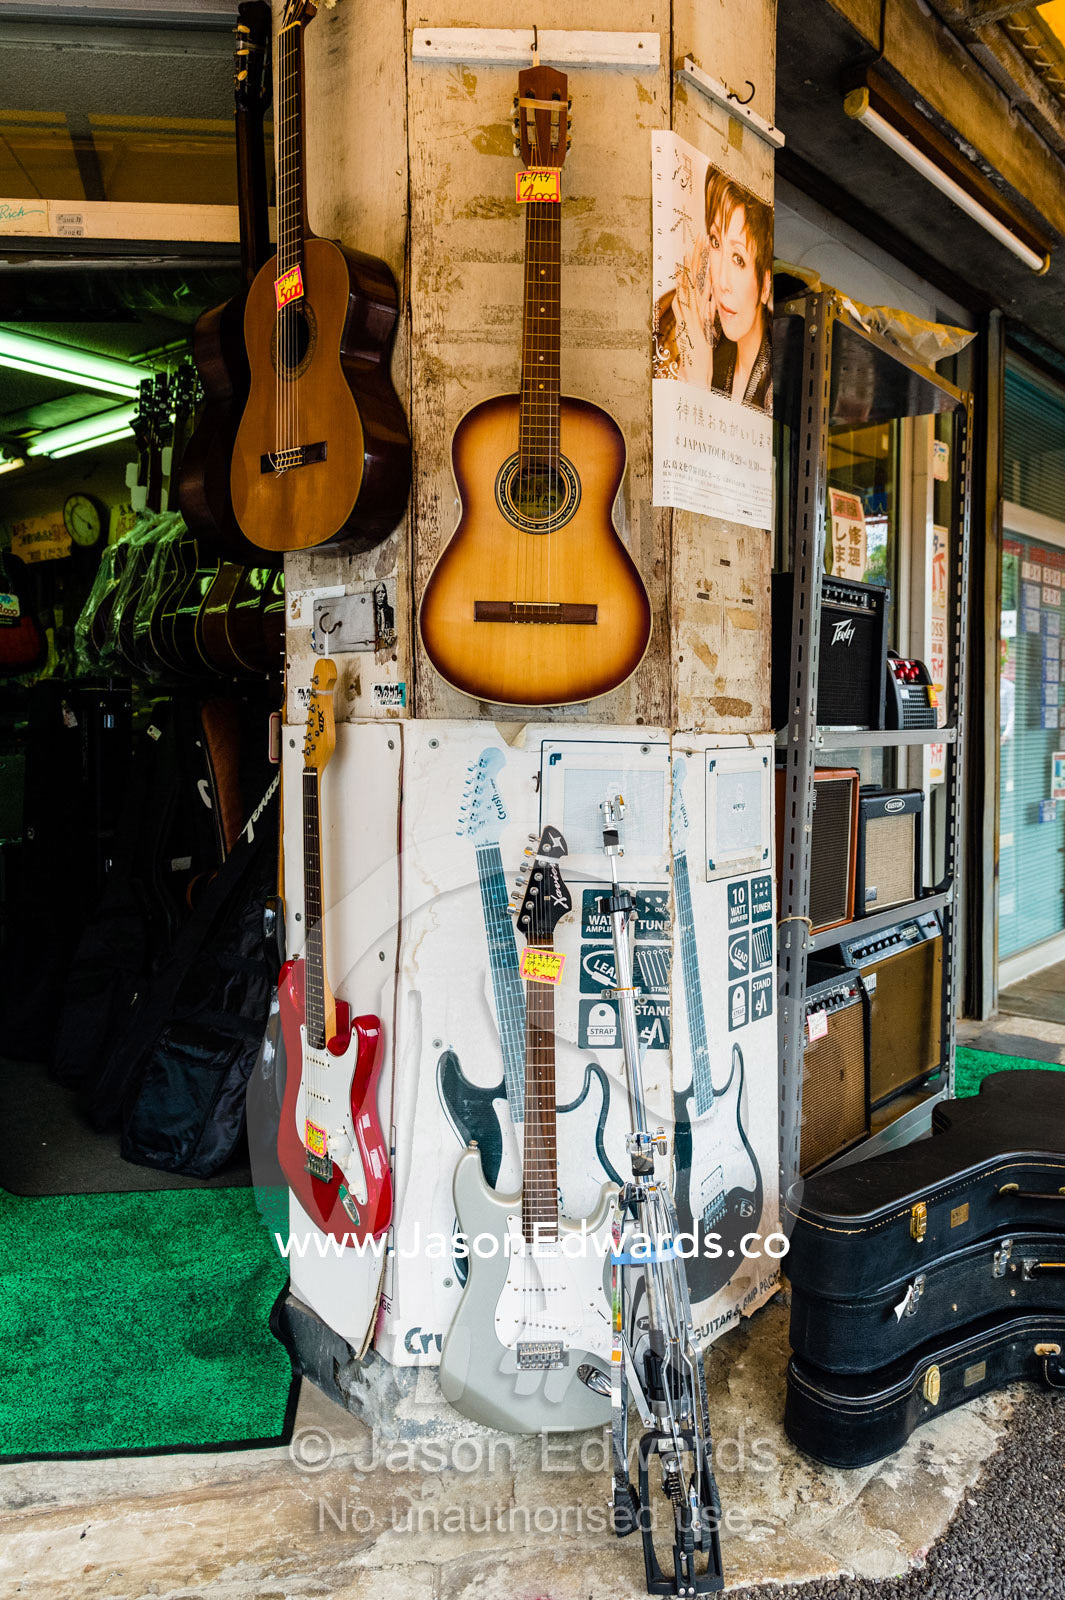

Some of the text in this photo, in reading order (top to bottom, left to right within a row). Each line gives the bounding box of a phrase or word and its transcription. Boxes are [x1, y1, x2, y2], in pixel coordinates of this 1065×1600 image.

[491, 793, 507, 820] Crush
[733, 887, 744, 904] 10
[731, 904, 746, 917] WATT
[753, 902, 771, 914] TUNER
[638, 920, 670, 931] TUNE
[735, 947, 748, 963] LEAD
[594, 960, 616, 979] LEA
[753, 978, 771, 992] STAND
[694, 1310, 732, 1341] GUITAR
